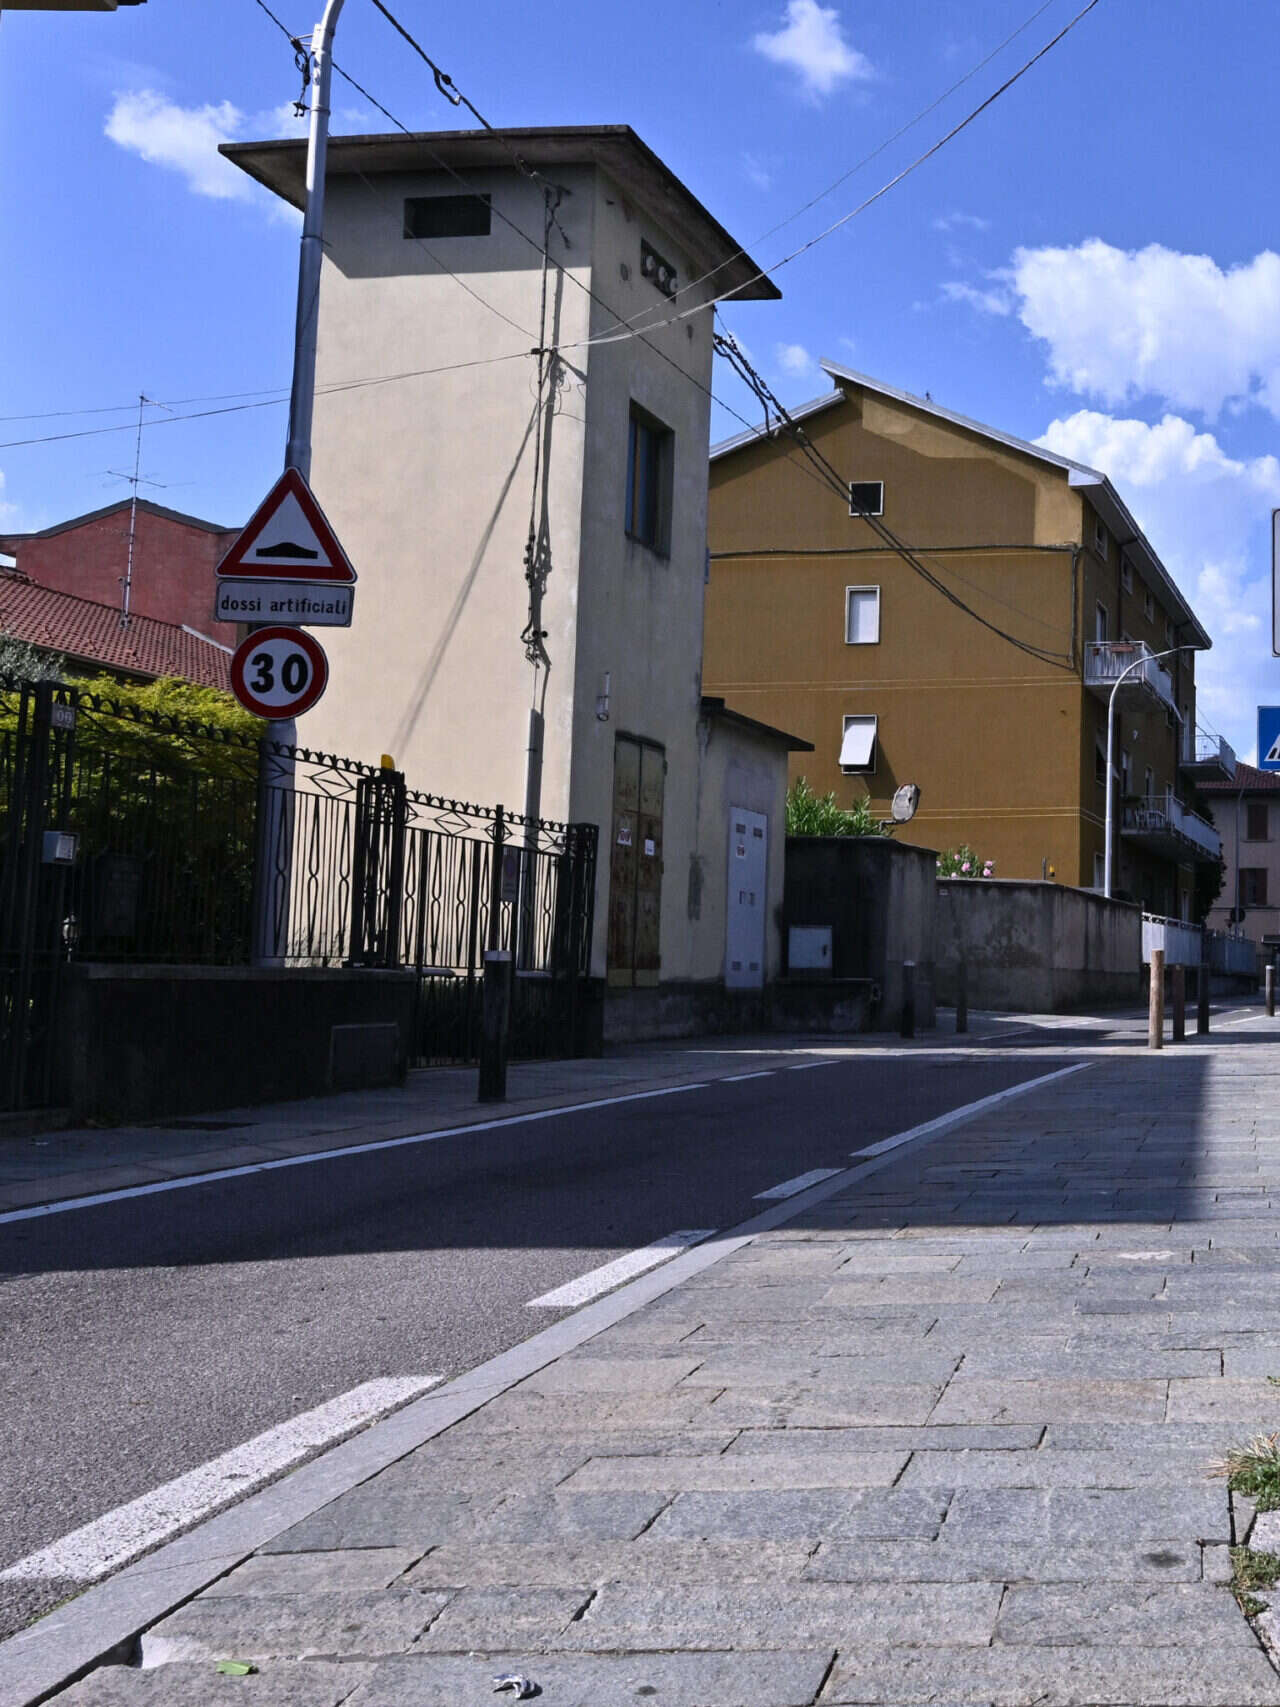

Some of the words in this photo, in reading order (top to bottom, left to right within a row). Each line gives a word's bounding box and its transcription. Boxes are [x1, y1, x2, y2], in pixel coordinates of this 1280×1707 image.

[221, 595, 261, 612] dossi
[270, 598, 346, 614] artificiali
[250, 653, 308, 694] 30
